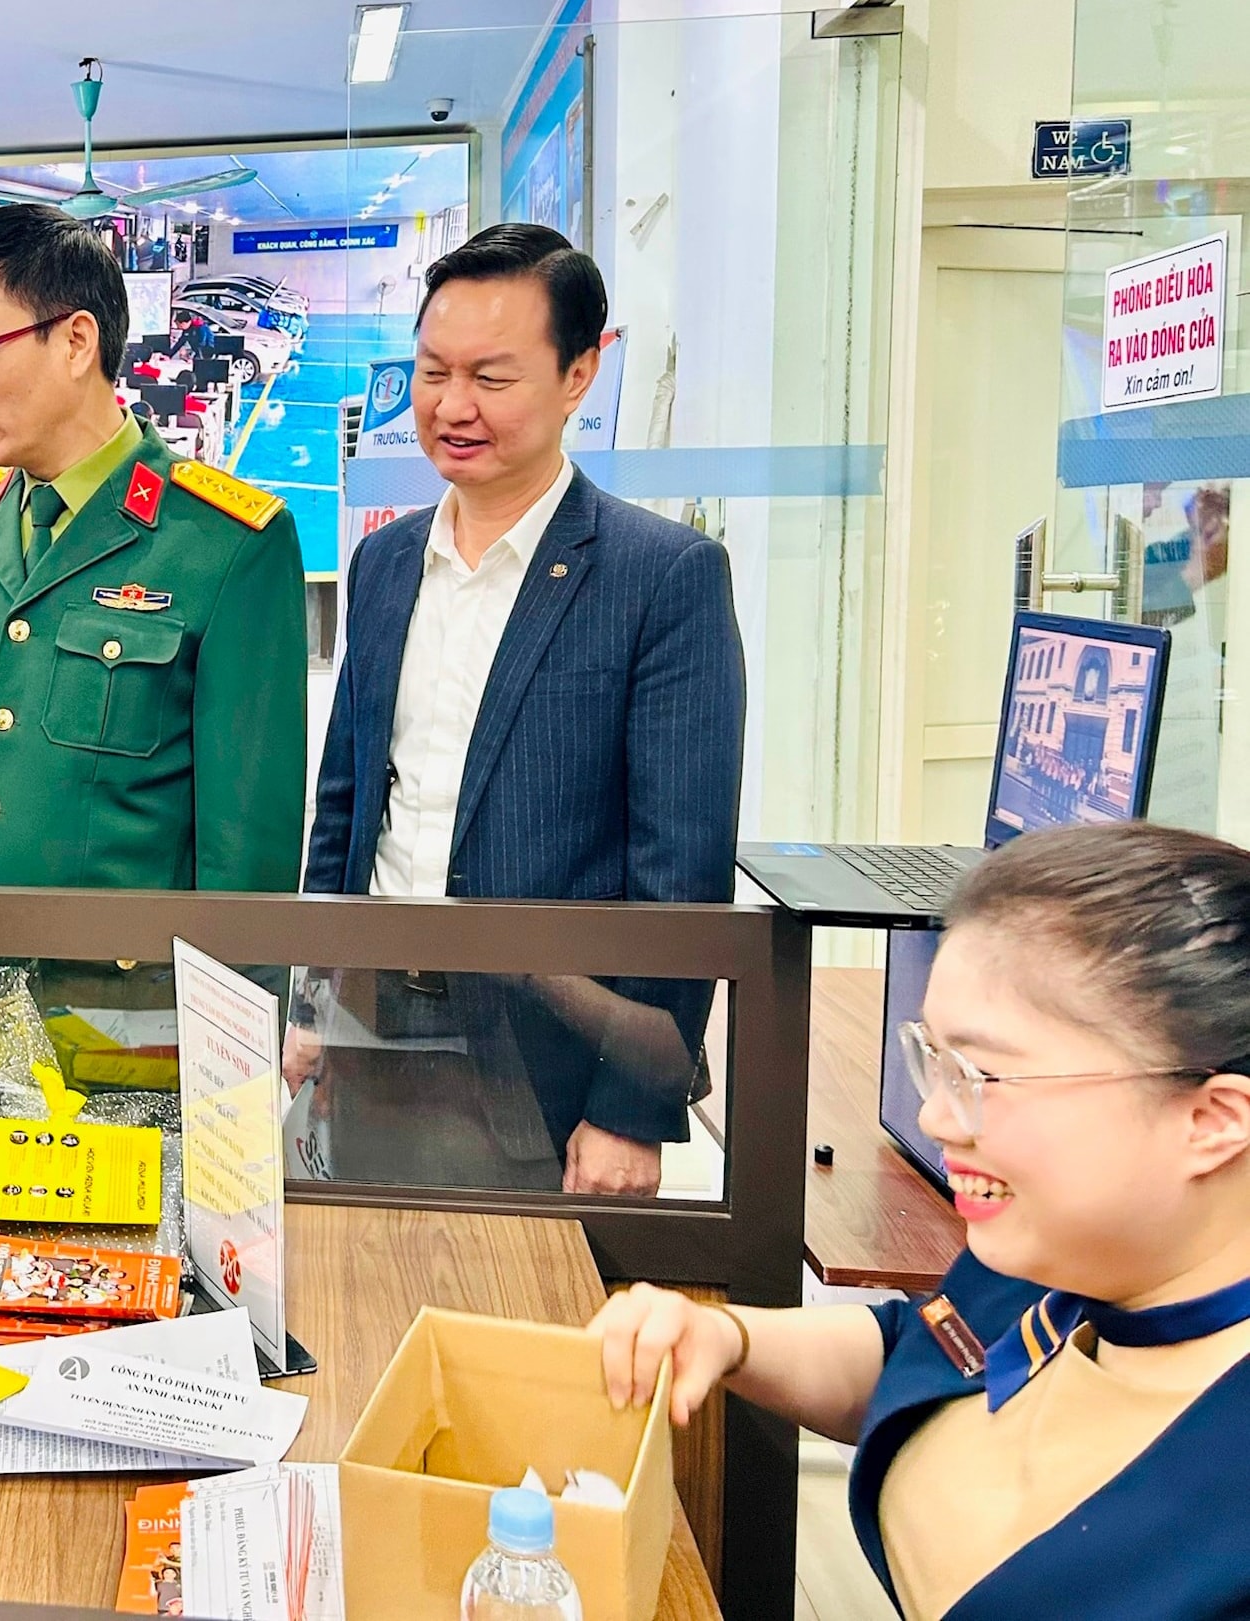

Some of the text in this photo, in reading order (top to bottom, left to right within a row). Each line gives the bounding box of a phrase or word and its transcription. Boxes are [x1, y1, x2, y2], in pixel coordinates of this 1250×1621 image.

[1051, 131, 1078, 146] WC
[1041, 155, 1086, 171] NAM
[1113, 257, 1214, 318] PHÒNG ĐIỀU HÒA
[1108, 308, 1216, 368] RA VÀO ĐÓNG CỬA
[1125, 365, 1195, 395] Xin cảm ơn!
[232, 1052, 249, 1078] SINH
[142, 1258, 161, 1285] ĐỊNH
[111, 1363, 249, 1405] CÔNG TY CỔ PHẦN DỊCH VỤ
[126, 1383, 223, 1412] AN NINH AKATSUKI
